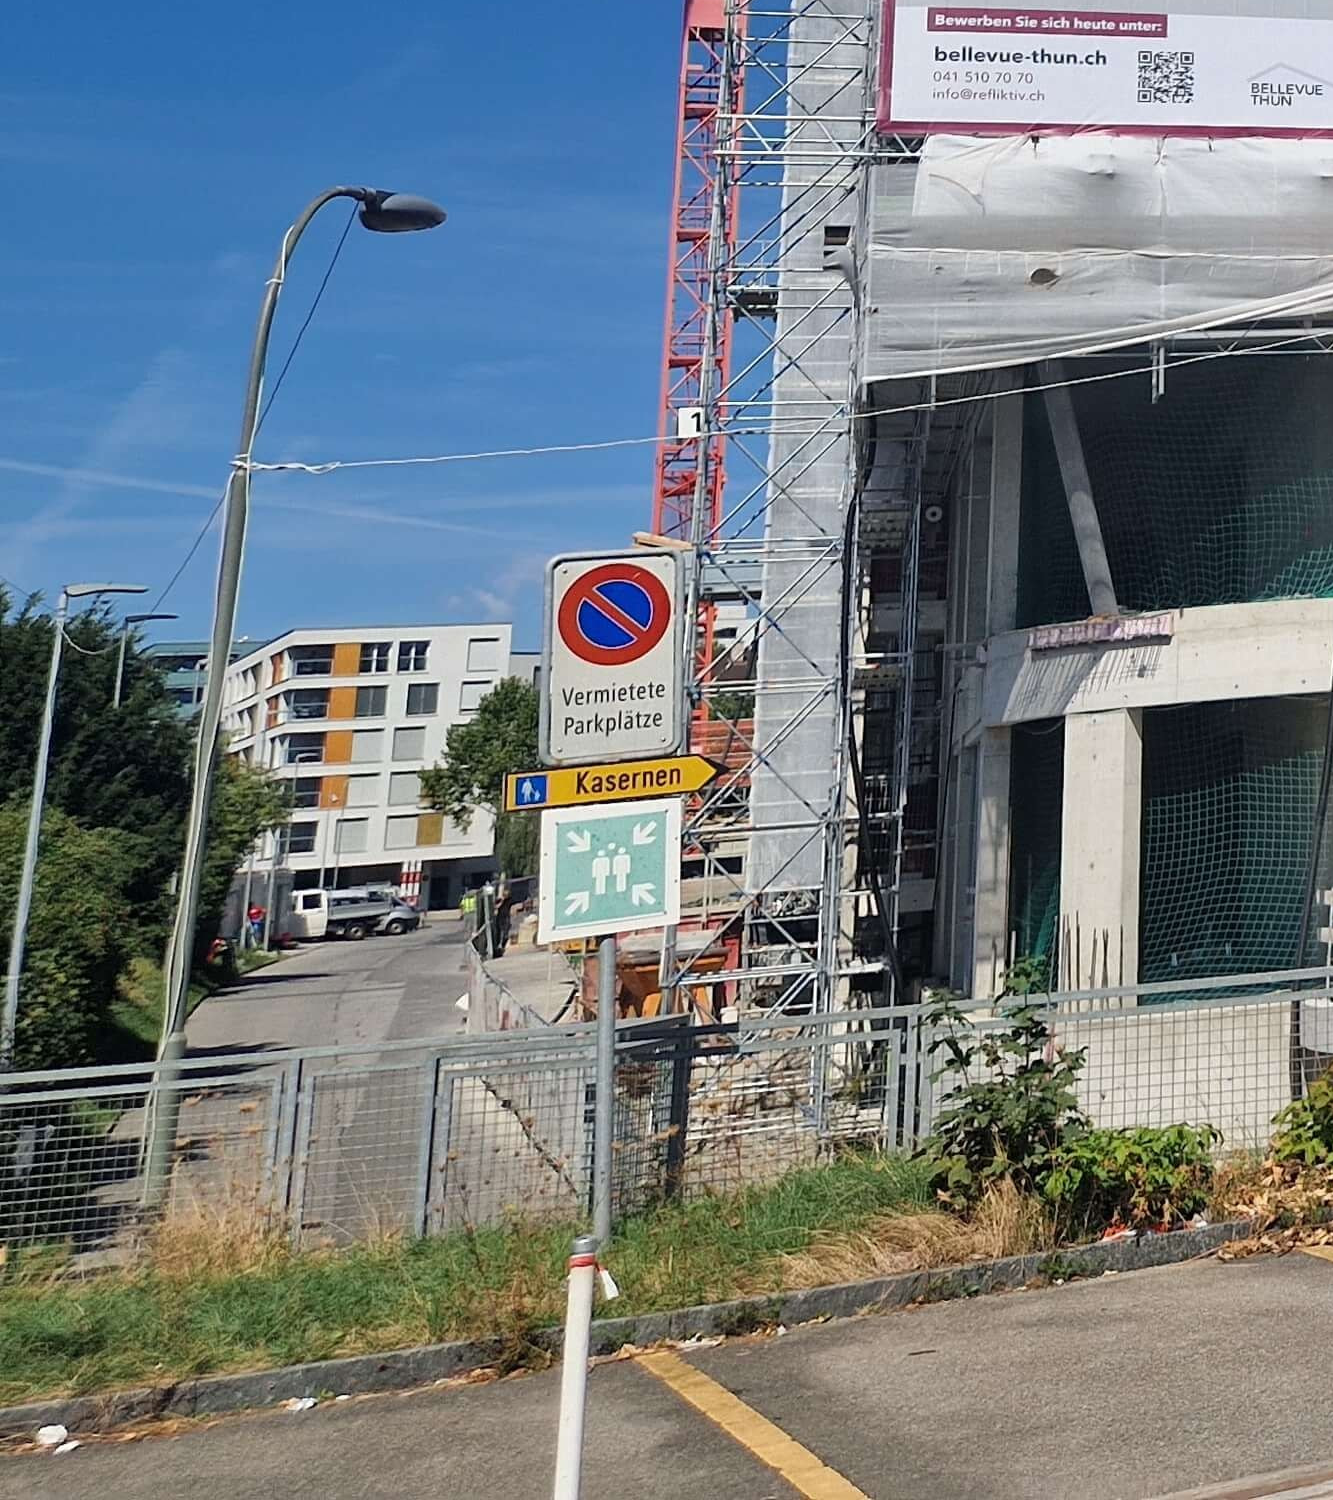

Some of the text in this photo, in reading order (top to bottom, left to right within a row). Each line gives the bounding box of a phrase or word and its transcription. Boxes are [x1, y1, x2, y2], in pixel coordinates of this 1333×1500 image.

[935, 14, 1162, 32] Bewerben Sie sich heute unter:
[935, 47, 1107, 65] bellevue-thun.ch
[933, 71, 1034, 85] 041 510 70 70
[933, 89, 1045, 101] info@refliktiv.ch
[1251, 83, 1323, 95] BELLEVUE
[1251, 95, 1292, 106] THUN
[691, 412, 701, 432] 1
[562, 683, 666, 707] Vermietete
[564, 710, 663, 737] Parkplätze
[576, 765, 681, 795] Kasernen
